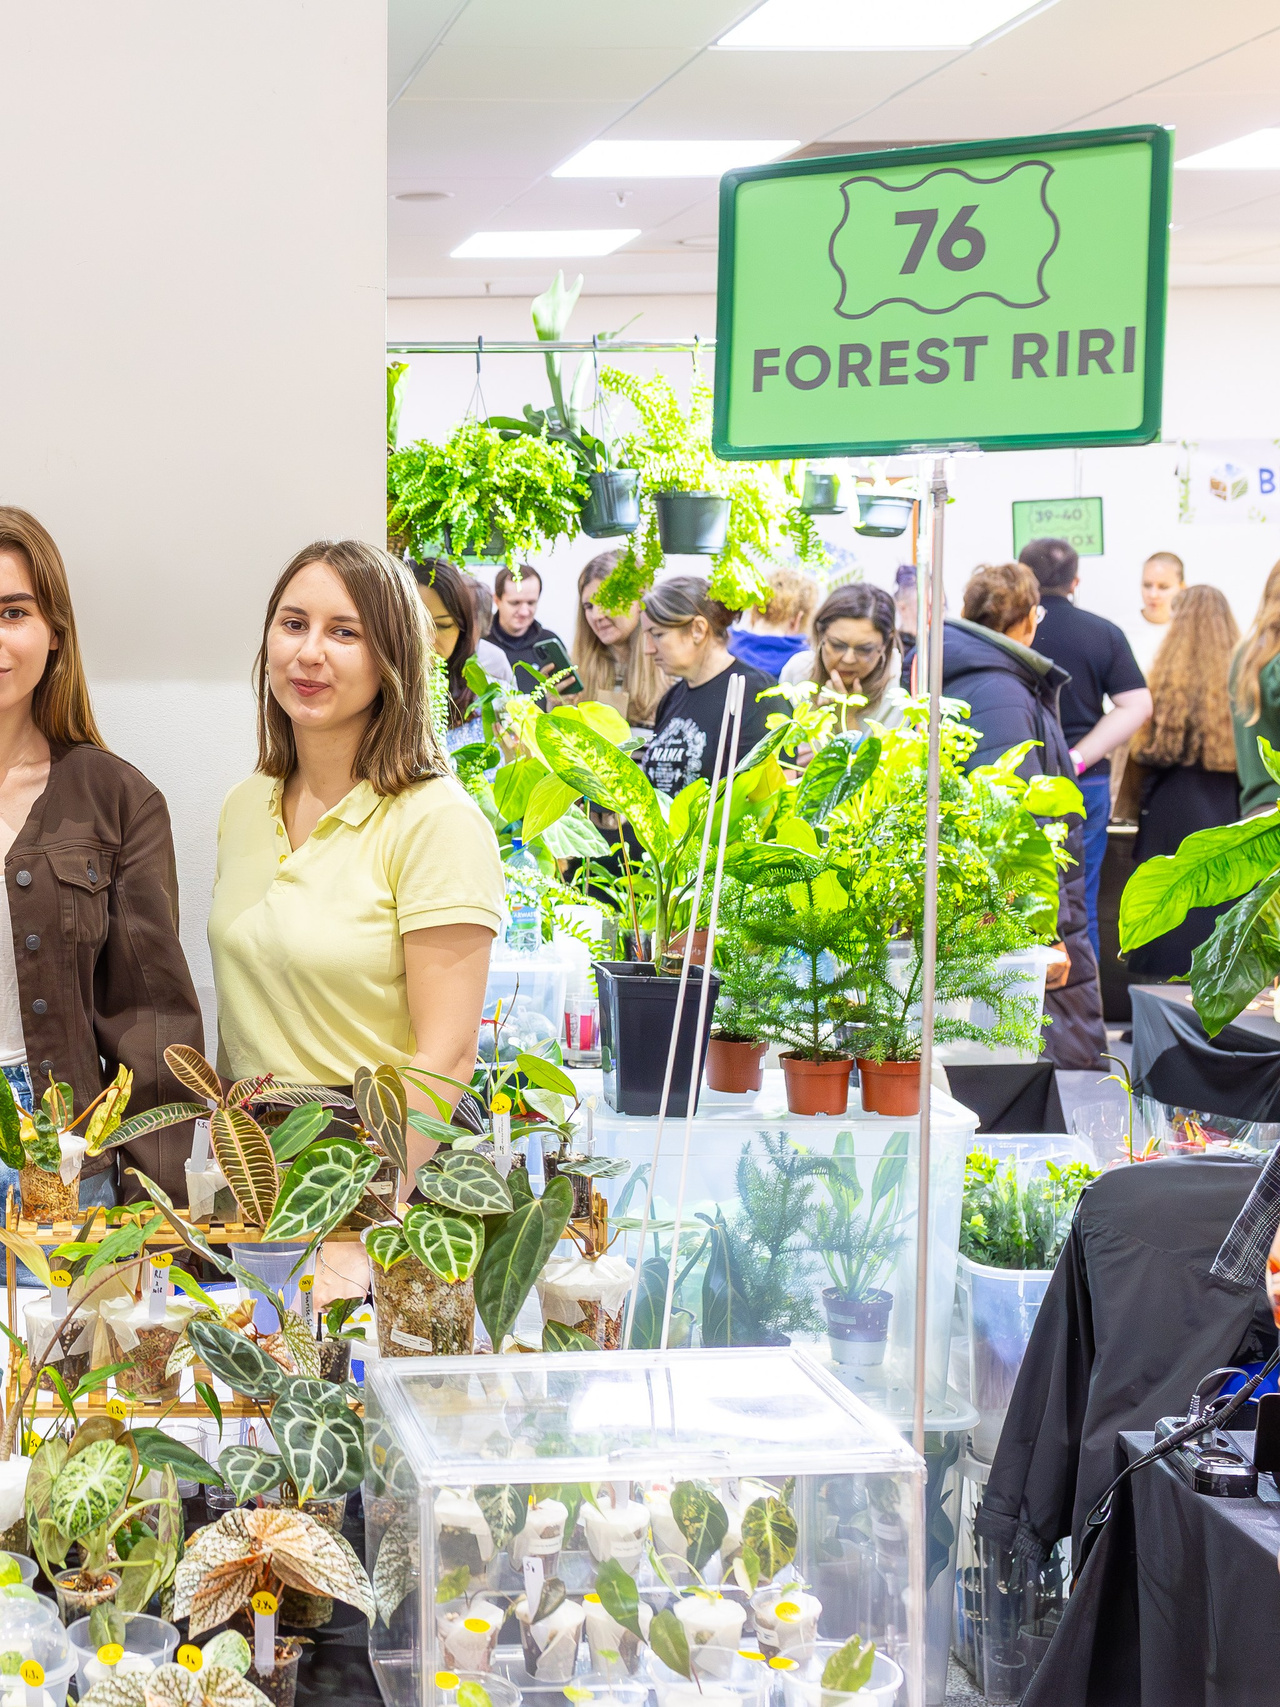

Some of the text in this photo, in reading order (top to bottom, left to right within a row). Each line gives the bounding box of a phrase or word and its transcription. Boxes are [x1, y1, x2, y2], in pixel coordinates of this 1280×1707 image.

[894, 204, 986, 275] 76
[752, 326, 1137, 392] FOREST RIRI
